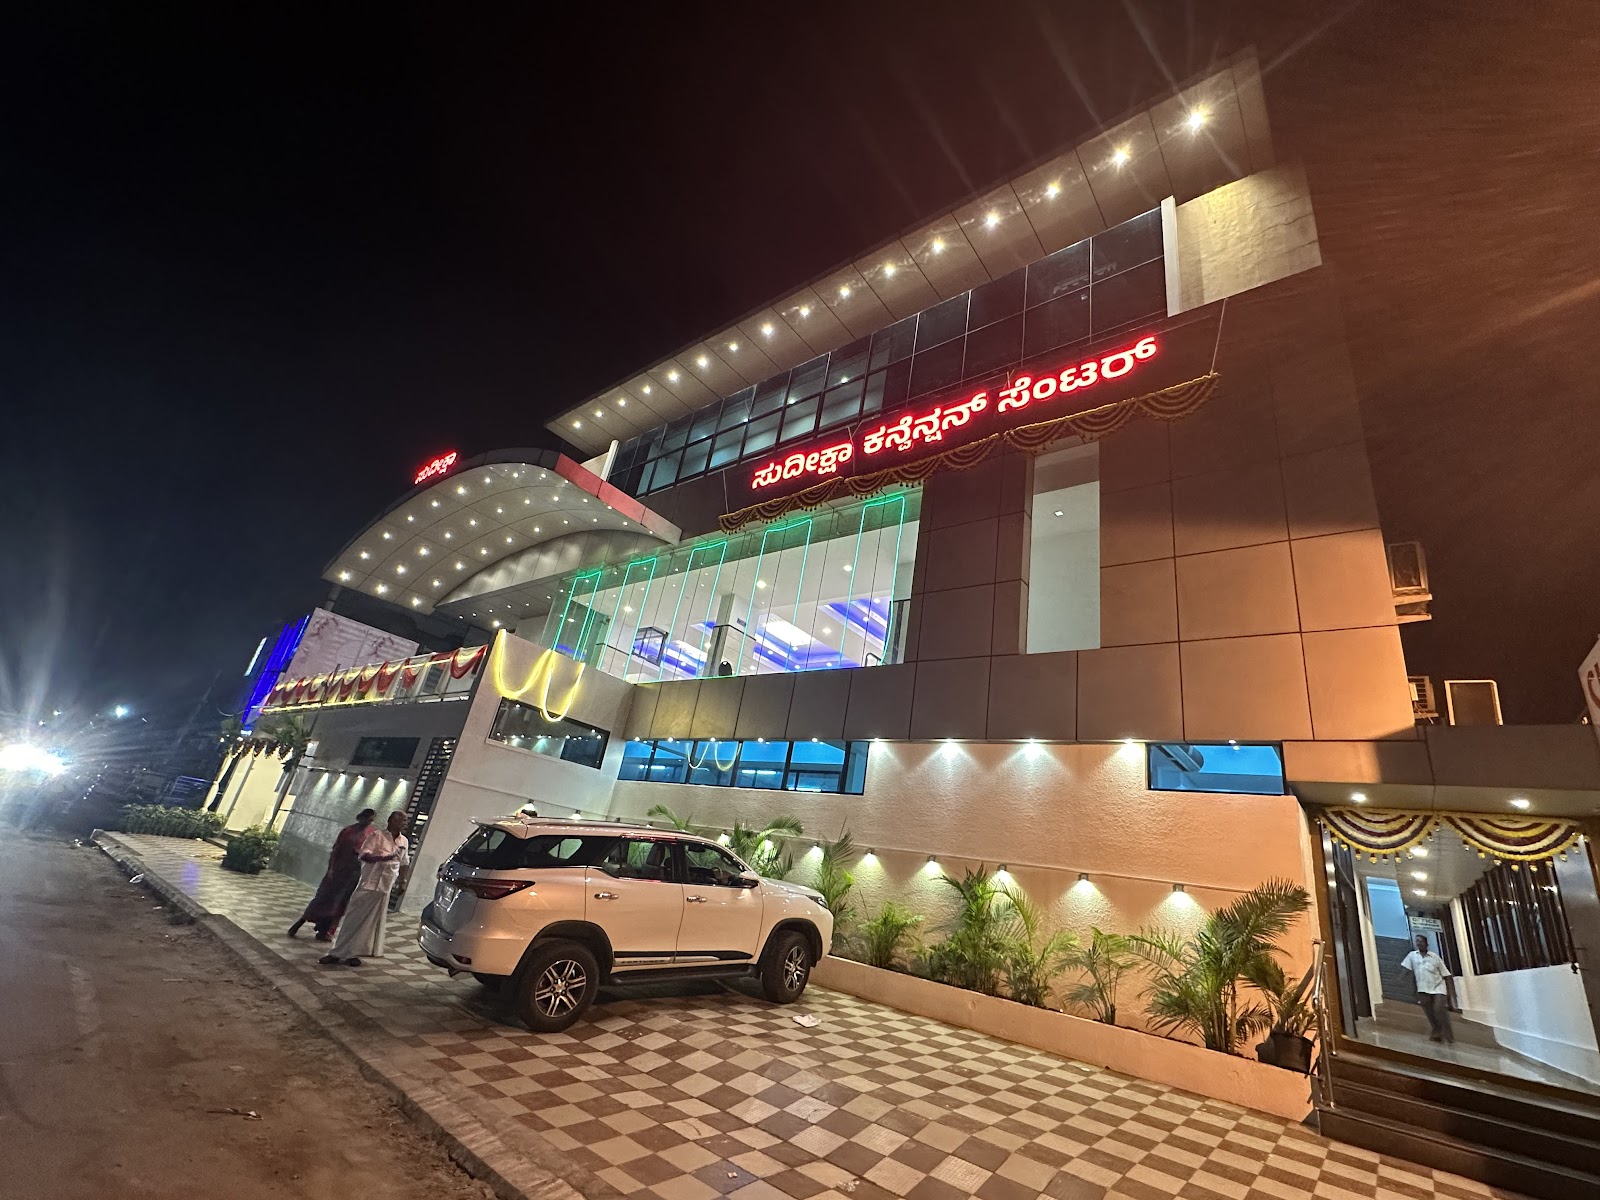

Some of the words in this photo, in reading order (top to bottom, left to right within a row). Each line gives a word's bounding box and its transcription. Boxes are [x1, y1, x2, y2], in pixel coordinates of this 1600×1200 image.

[752, 442, 852, 489] ಸುದೀಕ್ಷಾ
[863, 392, 987, 454] ಕನ್ವೆನ್ಷನ್
[998, 336, 1157, 413] ಸೆಂಟರ್
